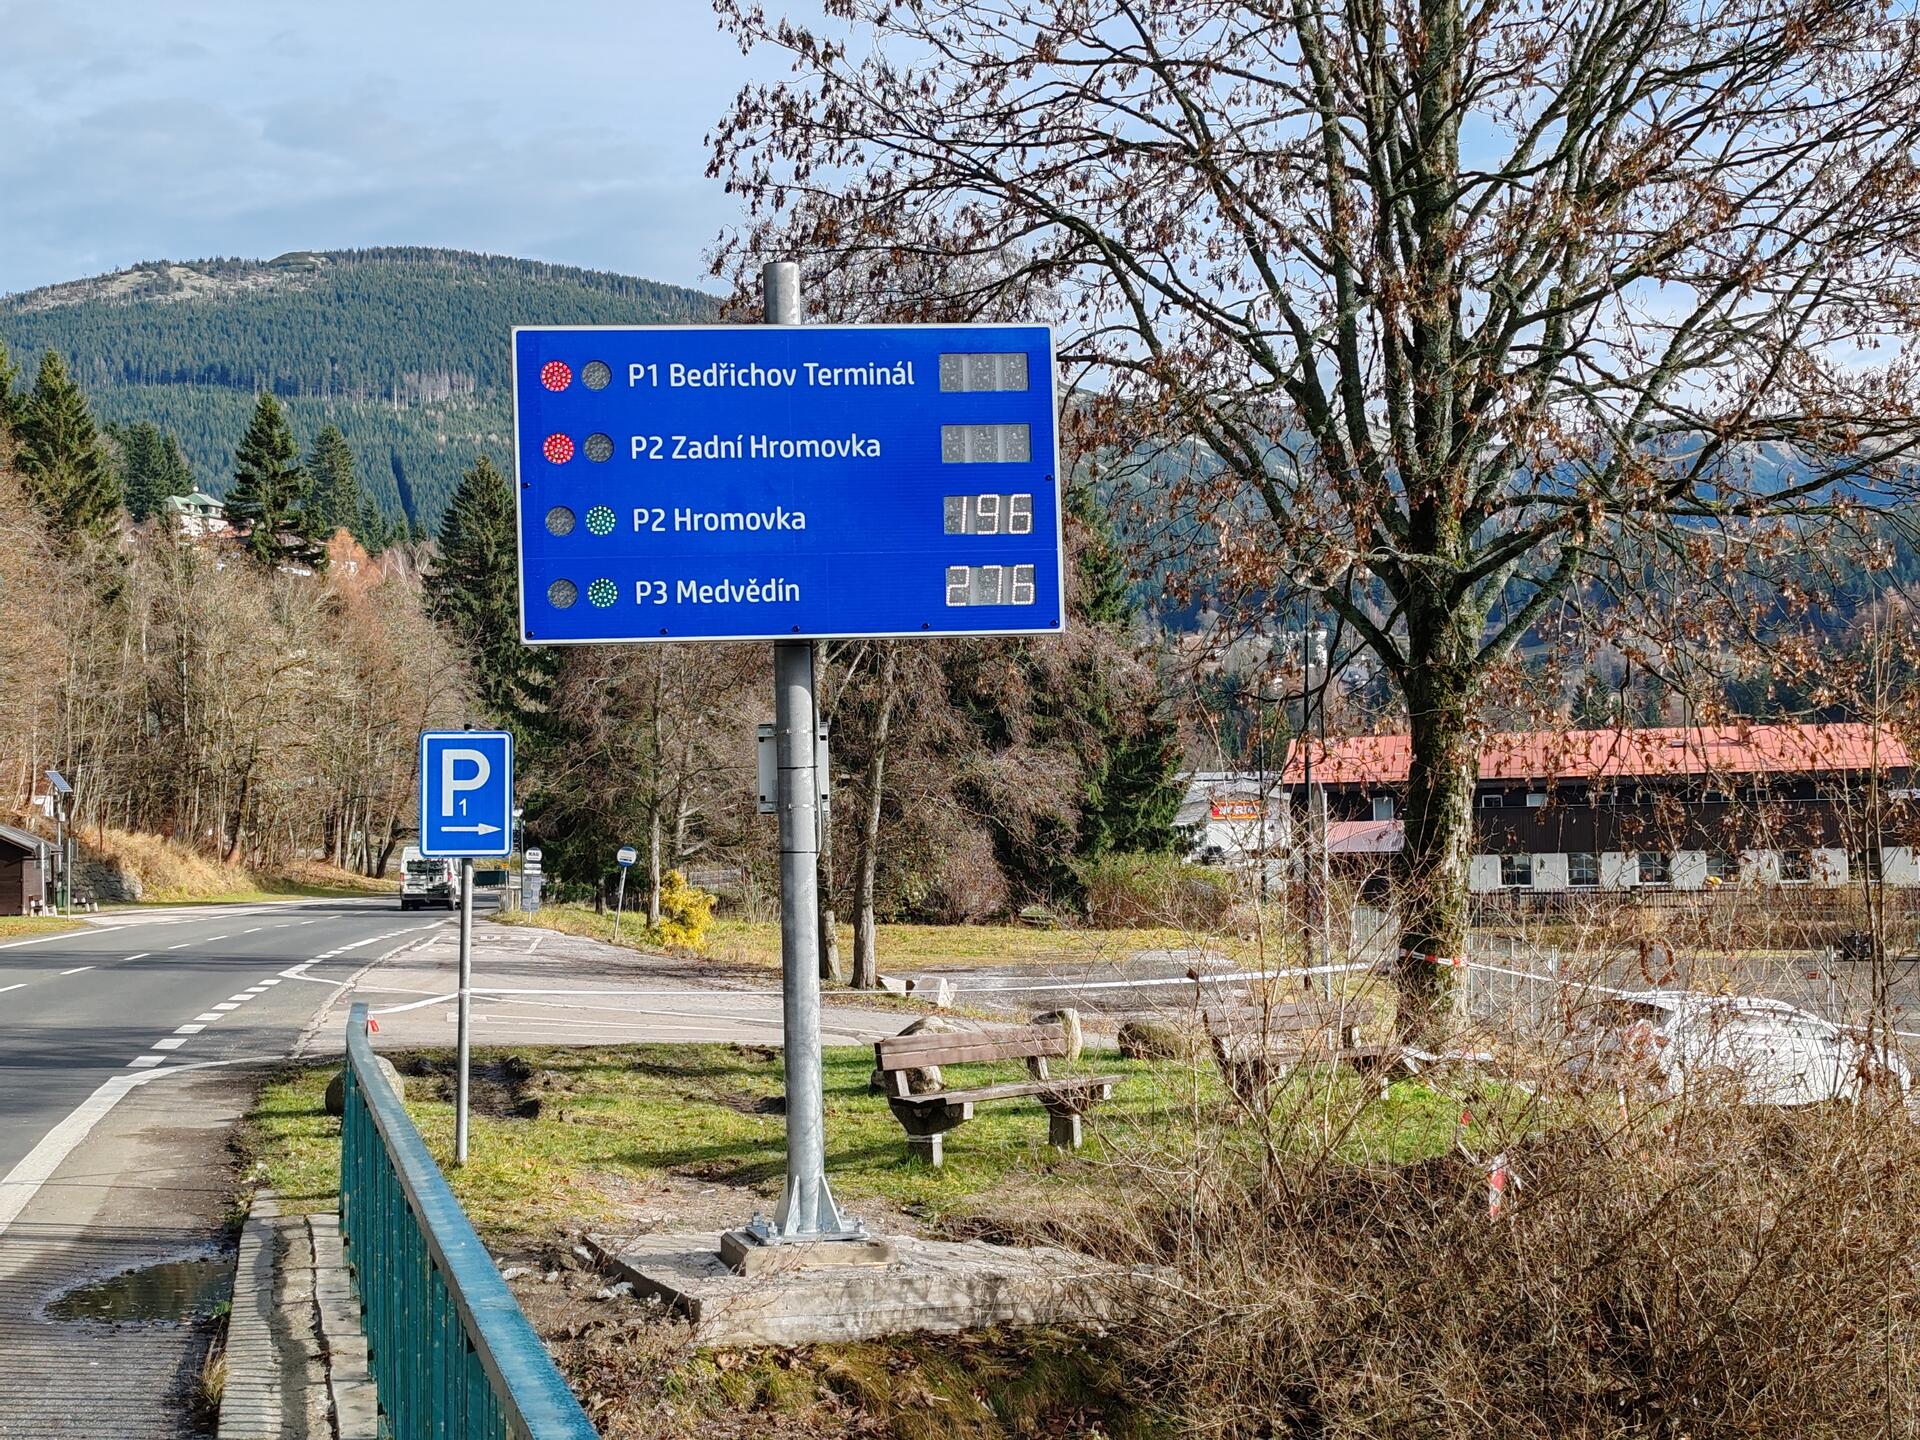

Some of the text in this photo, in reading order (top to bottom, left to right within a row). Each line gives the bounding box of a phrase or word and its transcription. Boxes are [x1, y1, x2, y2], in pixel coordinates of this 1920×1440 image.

[630, 360, 915, 387] P1 Bedřichov Terminál
[631, 433, 881, 460] P2 Zadní Hromovka
[633, 506, 806, 532] P2 Hromovka
[961, 494, 1032, 535] 196
[636, 577, 800, 605] P3 Medvědín
[946, 564, 1035, 606] 276
[441, 748, 491, 817] P
[458, 798, 467, 817] 1
